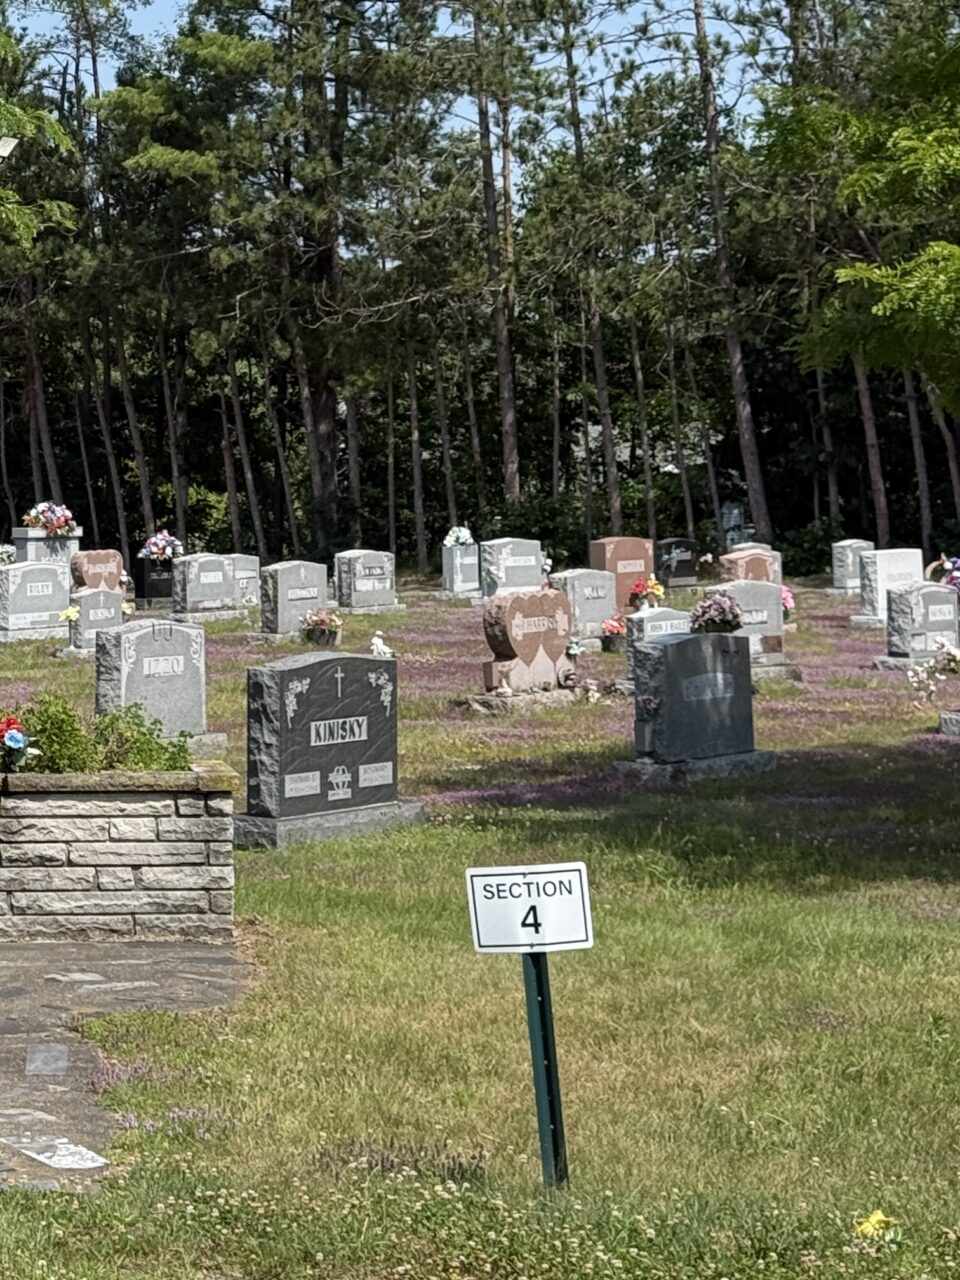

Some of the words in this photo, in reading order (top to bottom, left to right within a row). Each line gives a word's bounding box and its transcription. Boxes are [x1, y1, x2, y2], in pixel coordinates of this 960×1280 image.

[29, 583, 50, 594] RILEY
[147, 657, 181, 675] IZZO
[314, 718, 365, 743] KINISKY
[482, 879, 573, 900] SECTION
[520, 904, 542, 934] 4
